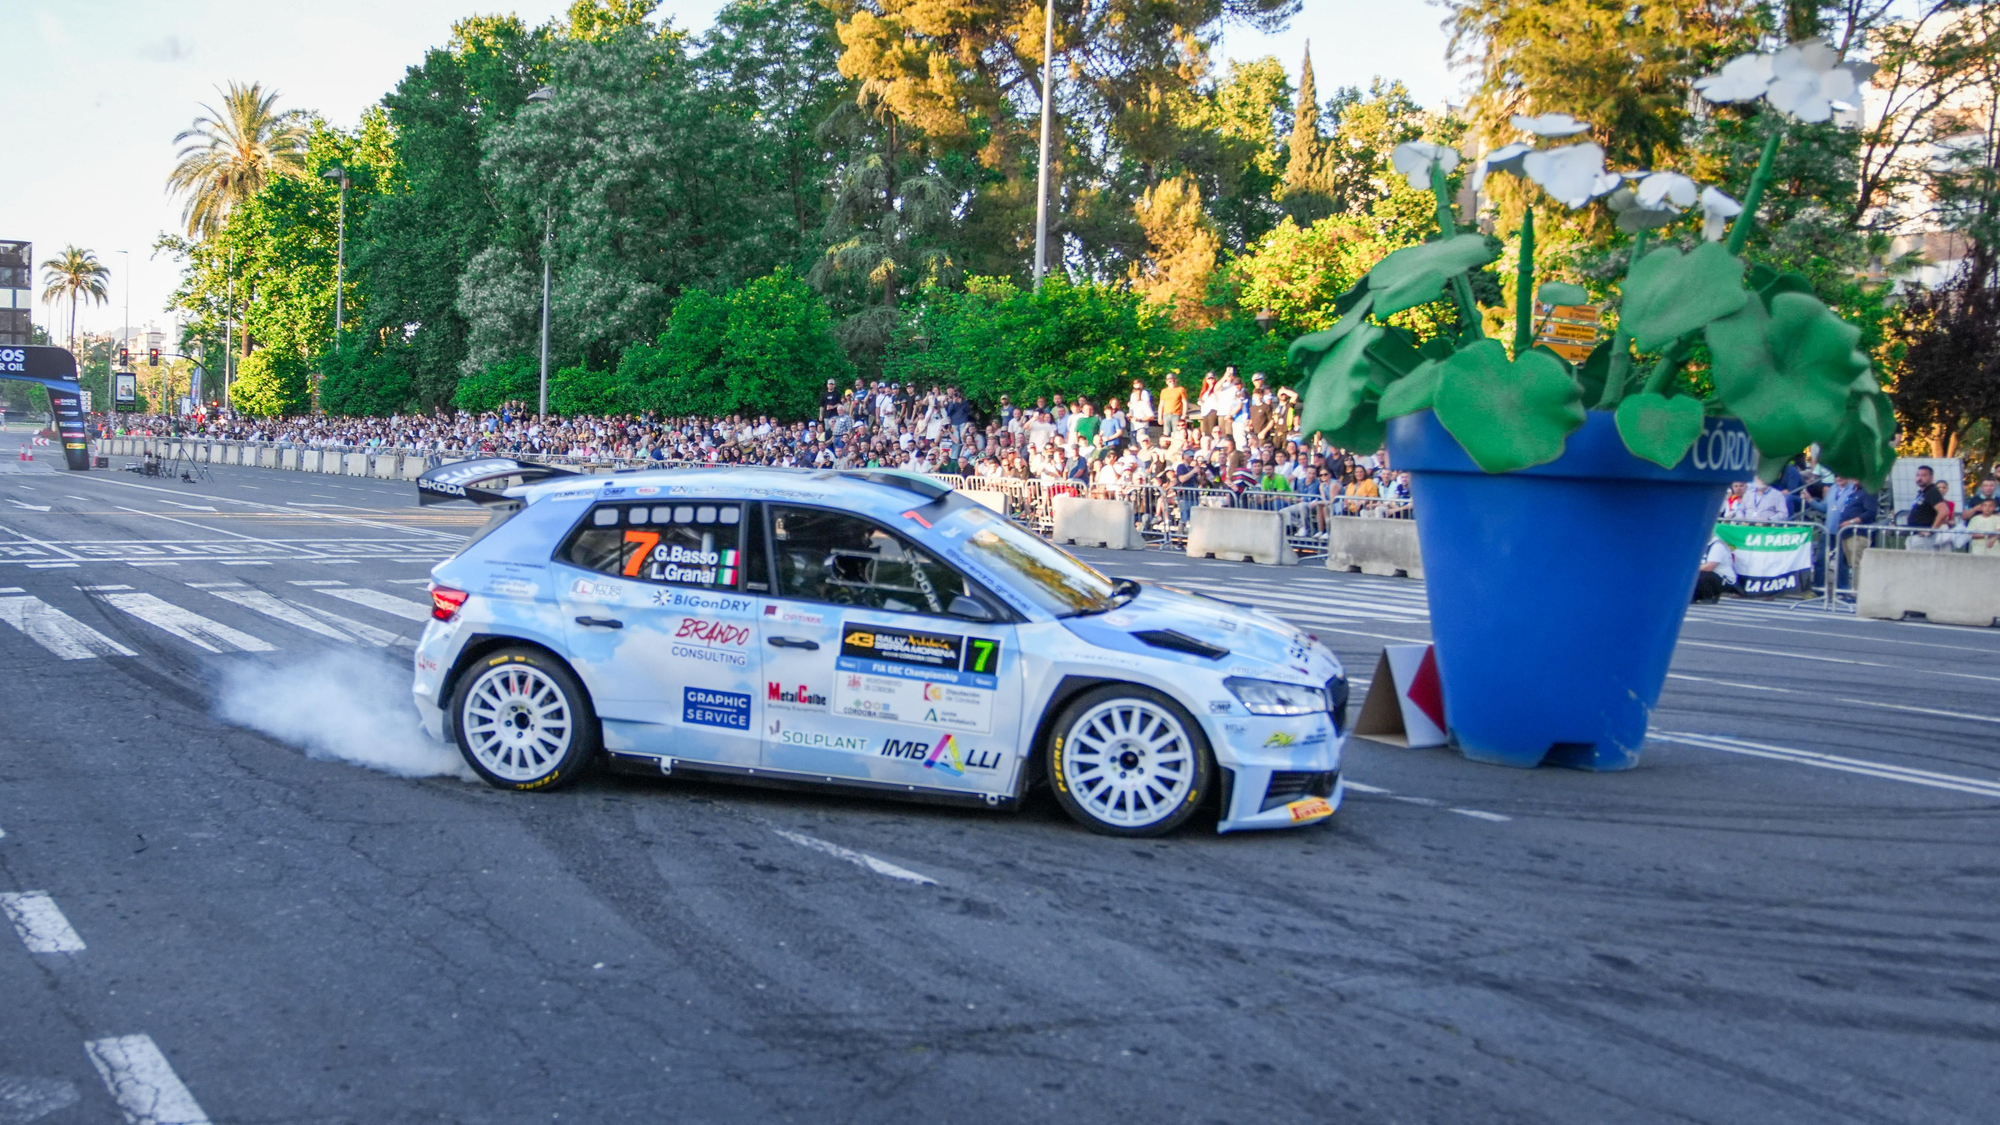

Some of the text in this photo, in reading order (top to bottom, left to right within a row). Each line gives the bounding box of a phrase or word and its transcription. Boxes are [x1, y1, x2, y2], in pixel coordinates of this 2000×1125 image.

[0, 349, 25, 362] OS
[8, 363, 25, 371] OIL
[1746, 534, 1761, 546] LA
[624, 530, 660, 577] 7
[654, 544, 719, 566] G.Basso
[650, 562, 717, 584] L.Granai
[1745, 575, 1796, 592] LA CAPA
[673, 594, 752, 613] BIGonDRY
[675, 618, 750, 648] BRANDO
[844, 631, 875, 649] 43
[875, 633, 908, 646] RALLY
[671, 646, 747, 666] CONSULTING
[973, 639, 995, 673] 7
[872, 662, 886, 674] FIA
[904, 667, 959, 683] Championship
[687, 691, 748, 709] GRAPHIC
[686, 708, 748, 727] SERVICE
[782, 729, 868, 751] SOLPLANT
[880, 733, 1002, 777] IMBALLI
